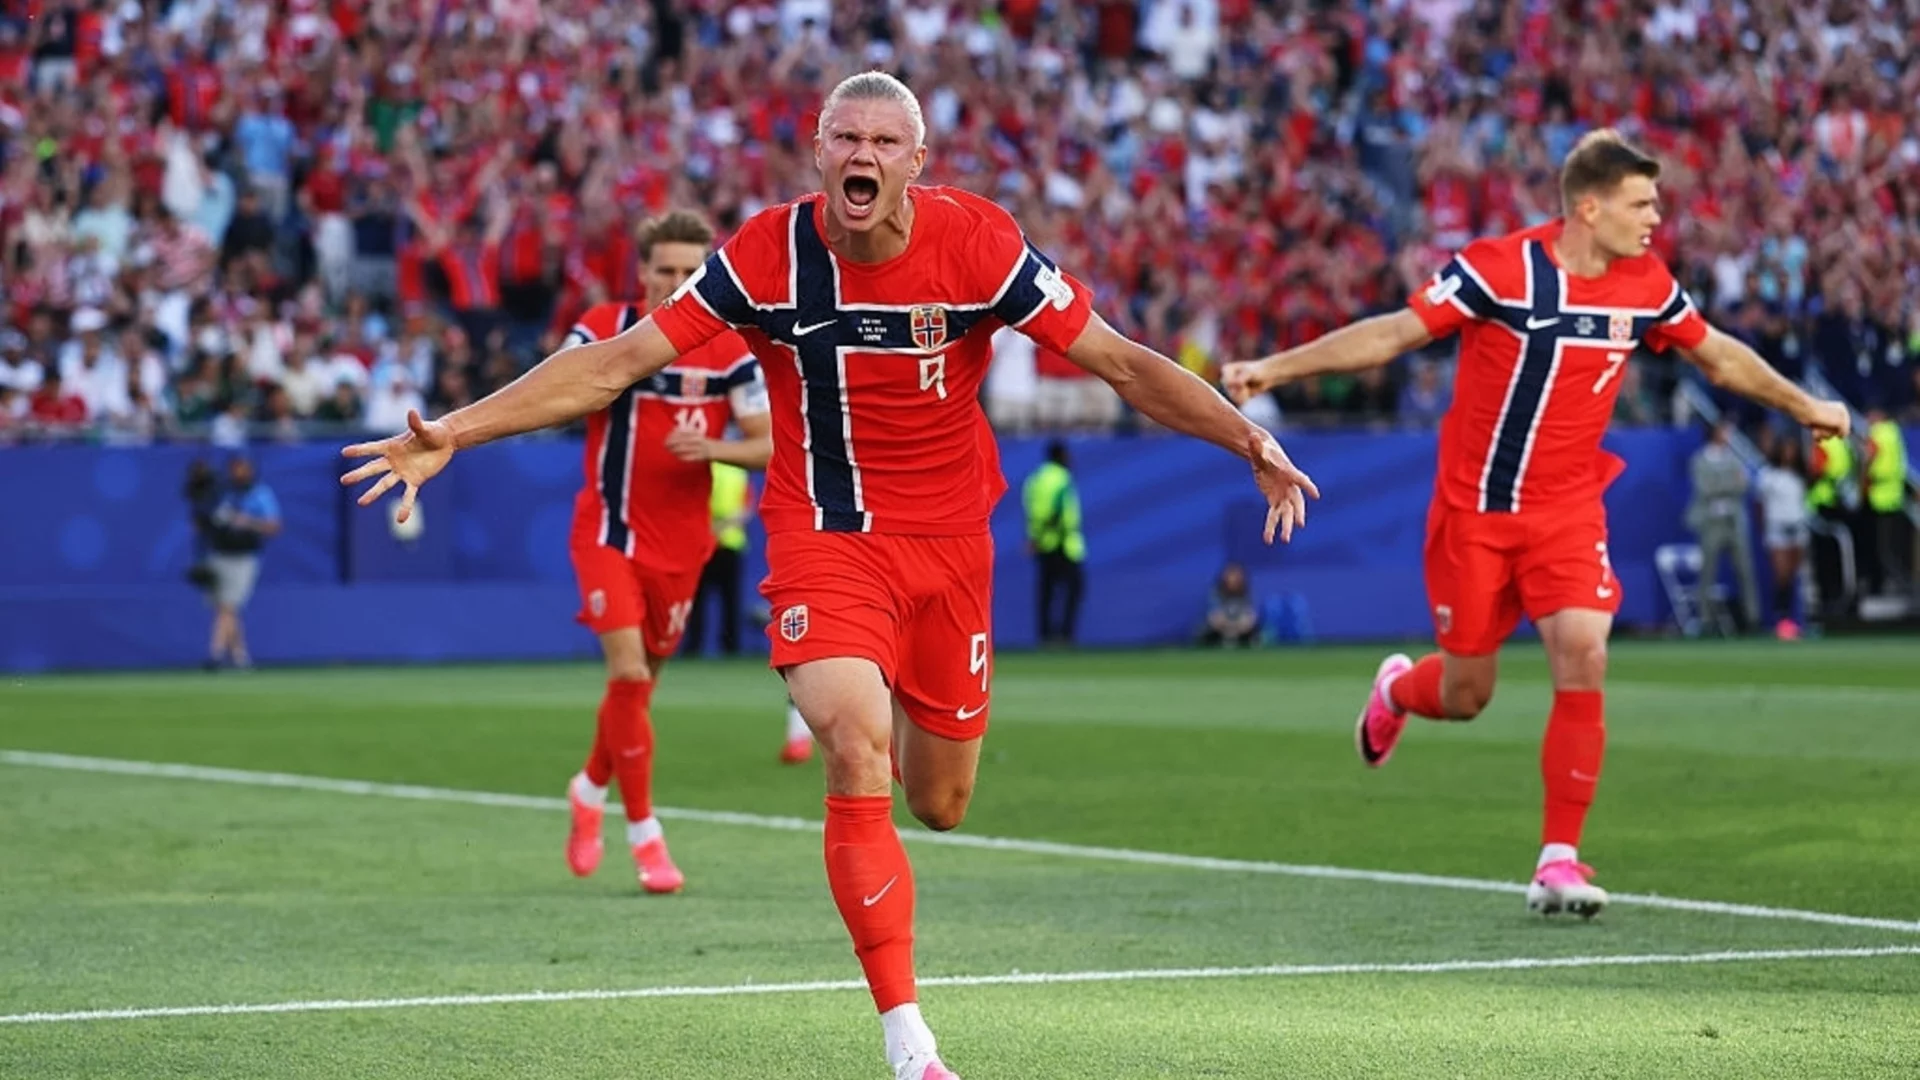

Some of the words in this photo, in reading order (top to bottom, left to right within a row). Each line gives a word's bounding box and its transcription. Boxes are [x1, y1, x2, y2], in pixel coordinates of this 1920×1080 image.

[918, 354, 948, 400] 9
[1592, 351, 1625, 396] 7
[968, 632, 988, 692] 9
